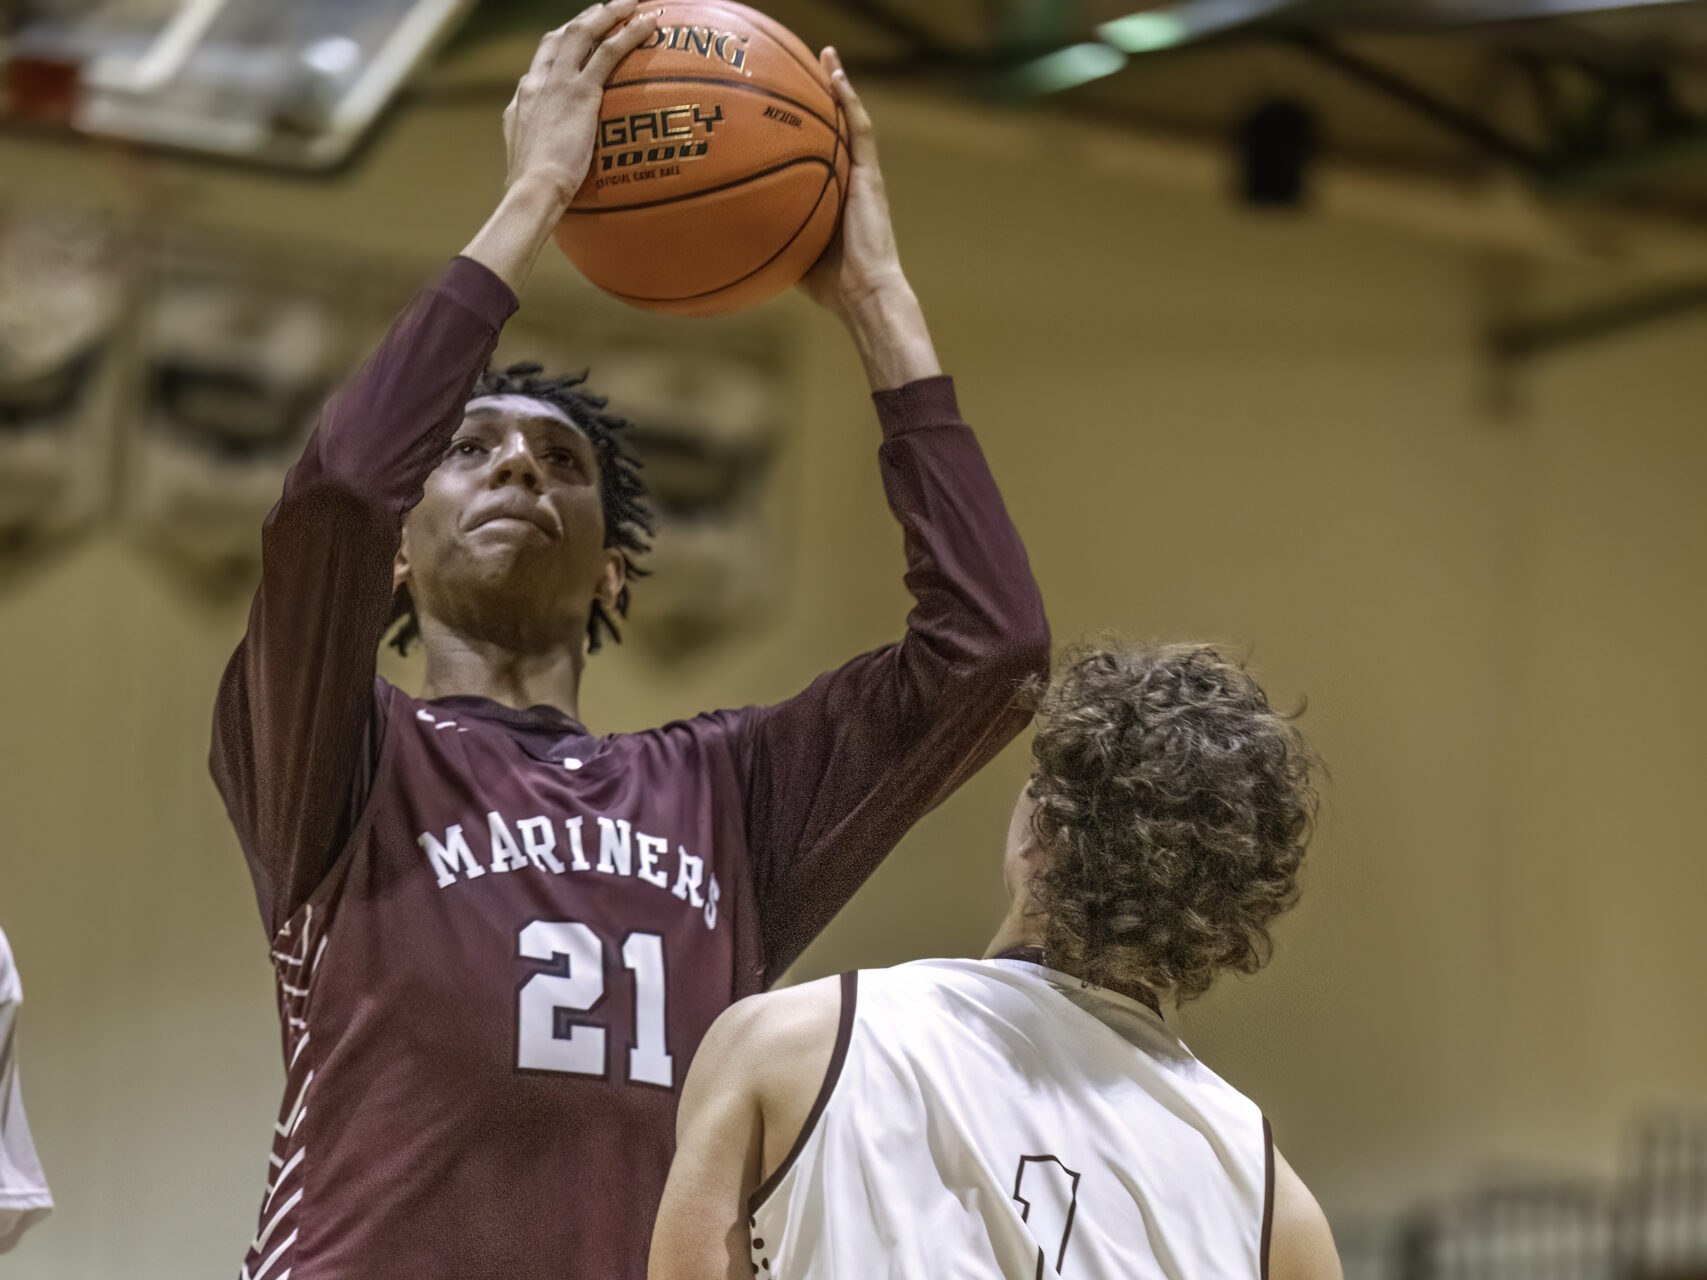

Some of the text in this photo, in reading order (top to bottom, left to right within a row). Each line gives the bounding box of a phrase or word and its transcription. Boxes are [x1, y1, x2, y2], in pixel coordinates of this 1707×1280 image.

[600, 141, 709, 171] 1000
[417, 811, 720, 930] MARINERS
[517, 919, 673, 1088] 21
